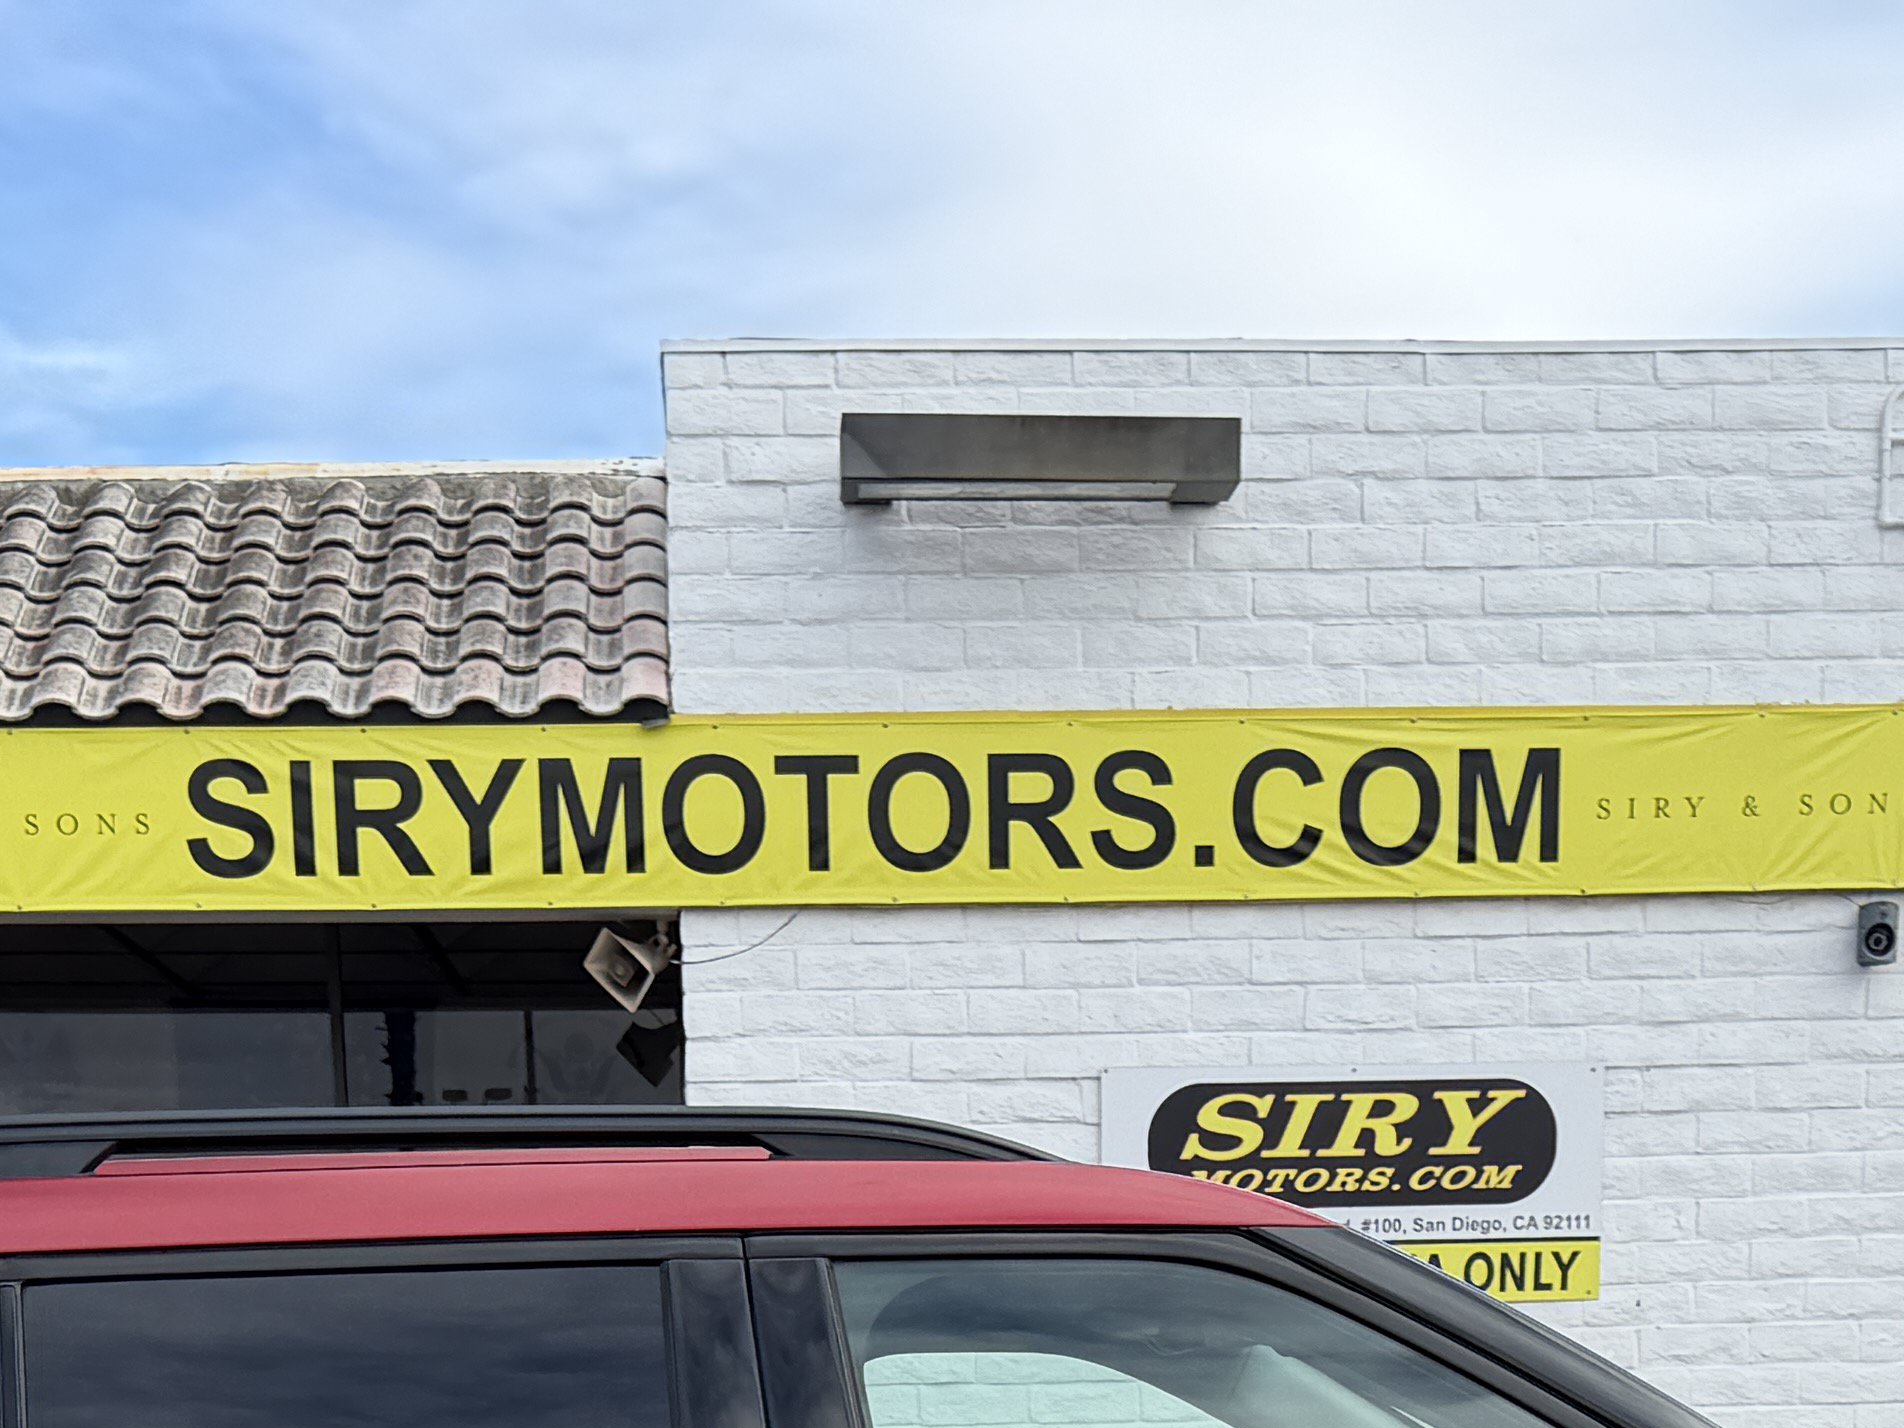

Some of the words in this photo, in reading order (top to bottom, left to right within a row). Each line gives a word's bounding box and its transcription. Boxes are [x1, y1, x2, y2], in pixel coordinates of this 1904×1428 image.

[24, 812, 153, 837] SONS
[186, 748, 1561, 880] SIRYMOTORS.COM
[1595, 796, 1708, 821] SIRY
[1741, 794, 1761, 819] &
[1179, 1088, 1528, 1162] SIRY
[1360, 1217, 1408, 1235] #100,
[1412, 1216, 1448, 1233] San
[1452, 1214, 1507, 1235] Diego,
[1512, 1216, 1539, 1232] CA
[1542, 1214, 1592, 1232] 92111
[1463, 1250, 1583, 1295] ONLY
